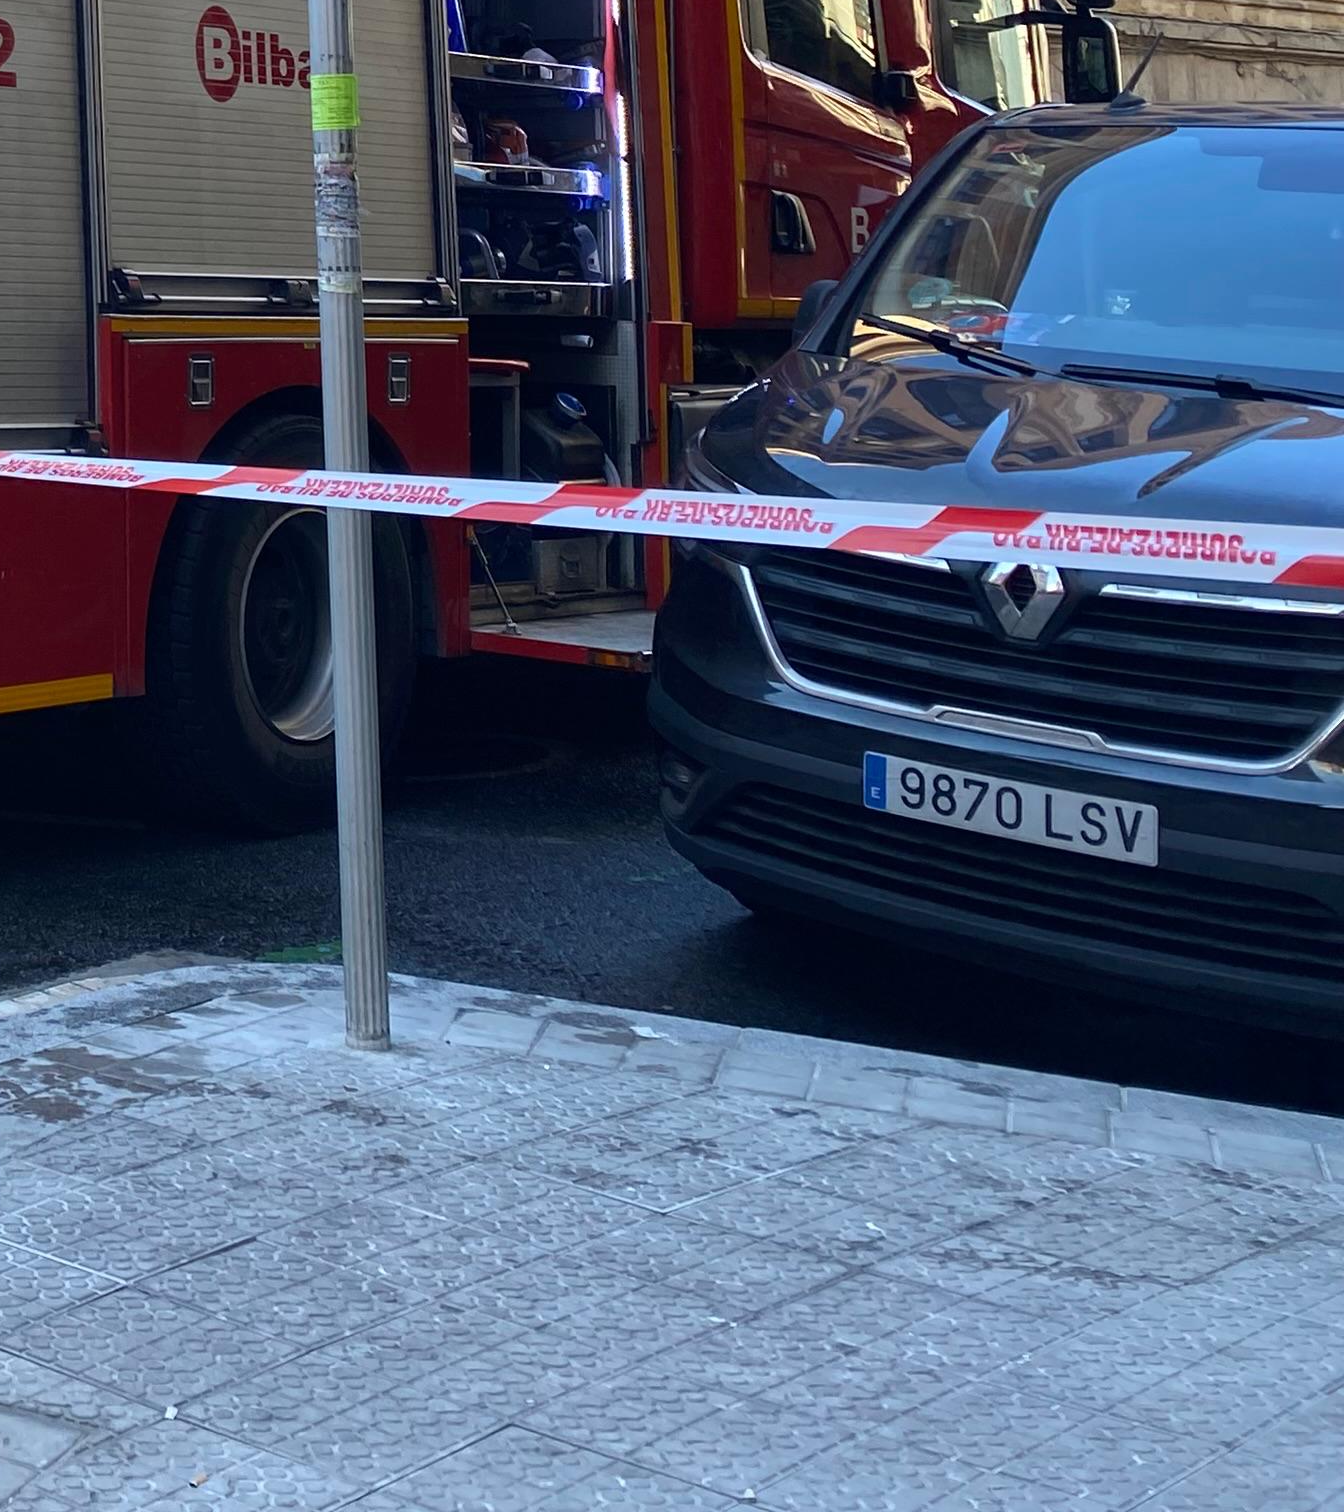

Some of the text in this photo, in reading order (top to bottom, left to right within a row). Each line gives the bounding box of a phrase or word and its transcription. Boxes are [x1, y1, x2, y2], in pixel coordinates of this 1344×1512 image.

[871, 787, 880, 799] E
[900, 767, 1143, 853] 9870 LSV
